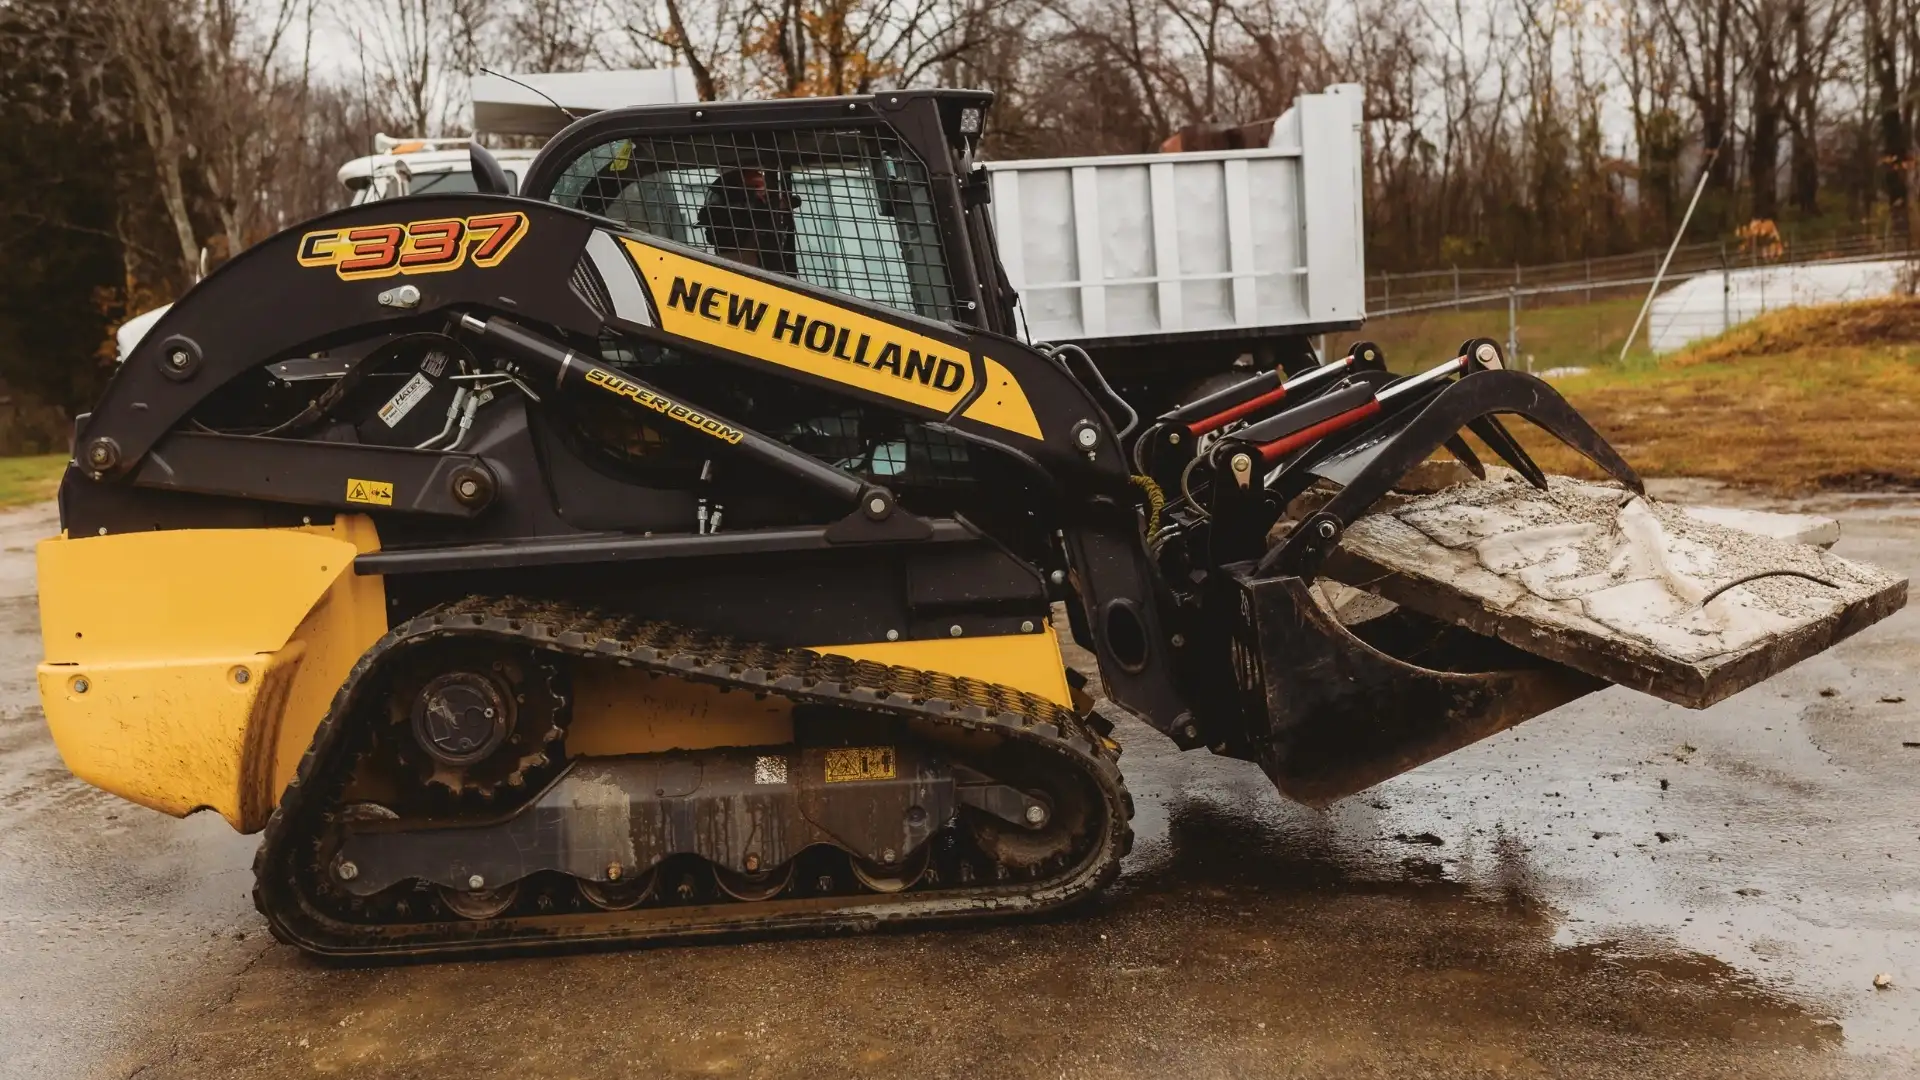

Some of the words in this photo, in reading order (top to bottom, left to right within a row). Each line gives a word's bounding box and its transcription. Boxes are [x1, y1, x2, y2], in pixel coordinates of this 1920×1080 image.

[298, 212, 528, 280] C337
[666, 276, 768, 333] NEW
[772, 308, 966, 393] HOLLAND
[586, 369, 671, 413] SUPER
[668, 404, 744, 444] BOOM
